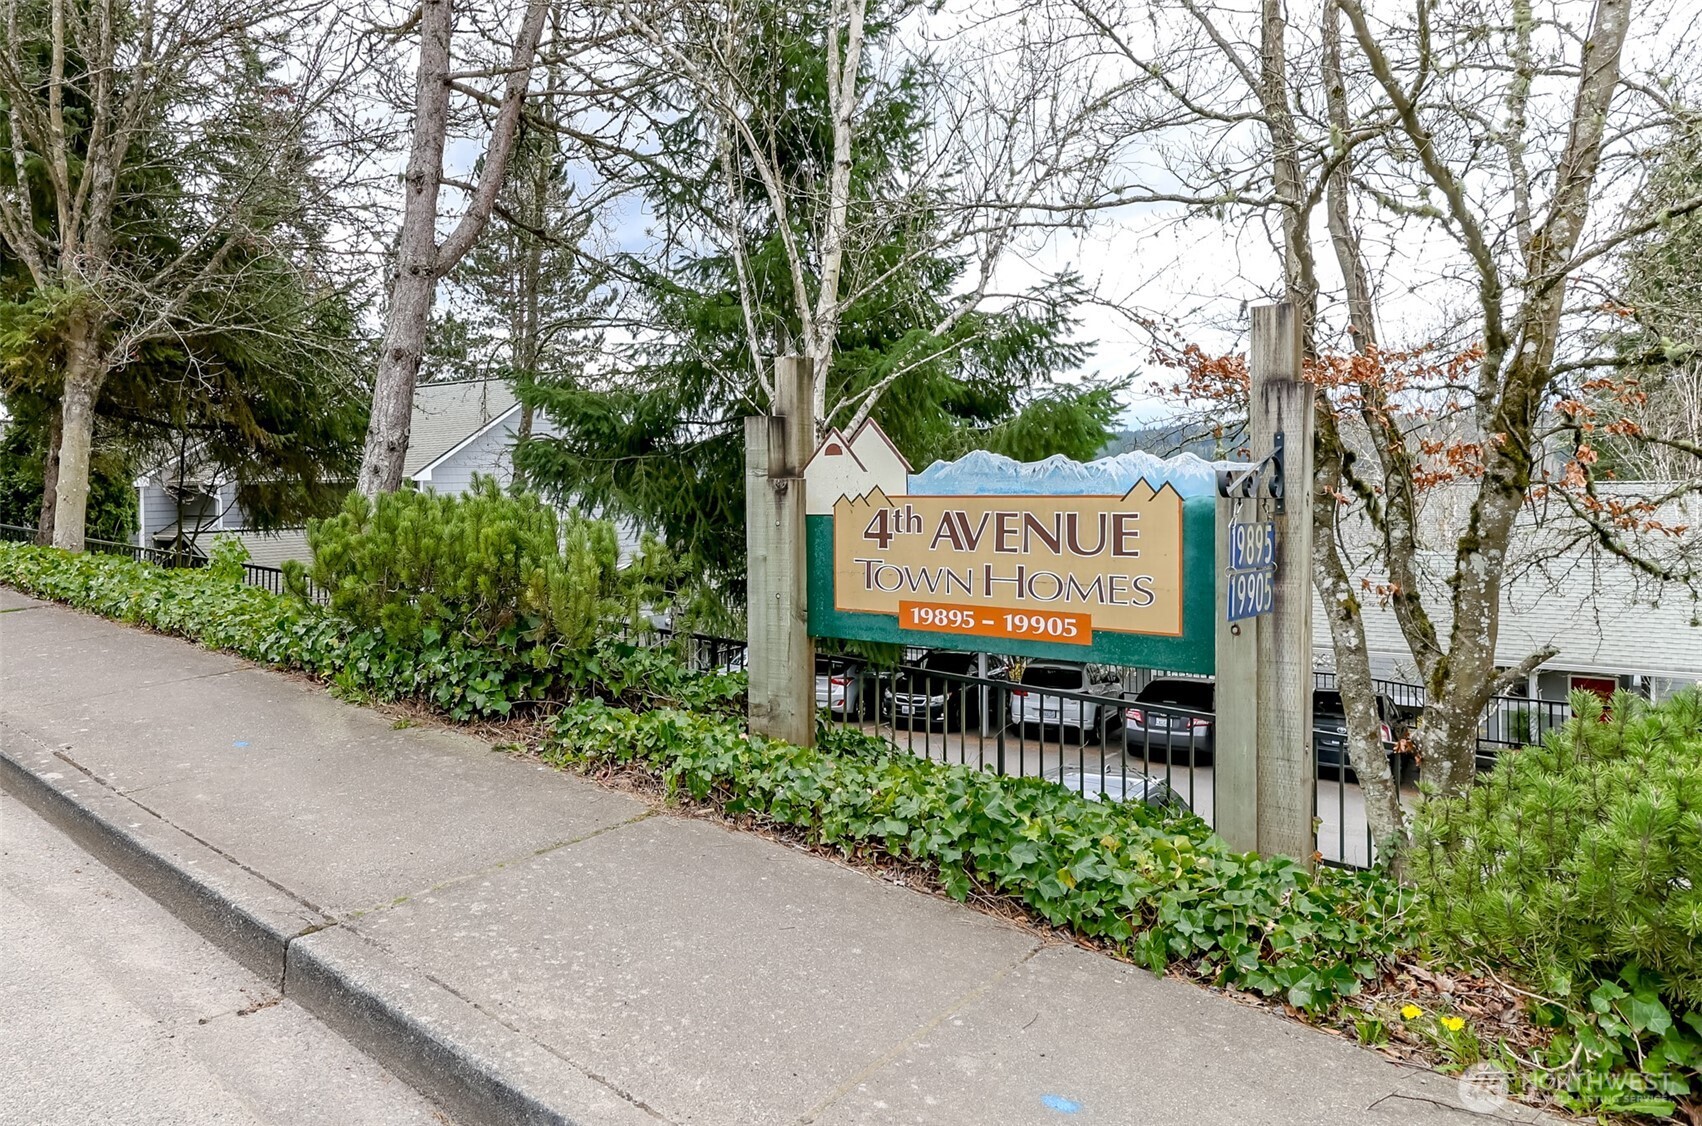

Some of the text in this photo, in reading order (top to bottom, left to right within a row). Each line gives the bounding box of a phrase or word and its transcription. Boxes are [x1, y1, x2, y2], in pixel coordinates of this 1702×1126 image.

[863, 504, 1140, 558] 4th AVENUE
[1232, 525, 1272, 569] 19895
[853, 557, 1156, 607] TOWN HOMES
[1231, 572, 1272, 617] 19905
[910, 607, 976, 629] 19895
[1003, 613, 1078, 637] 19905
